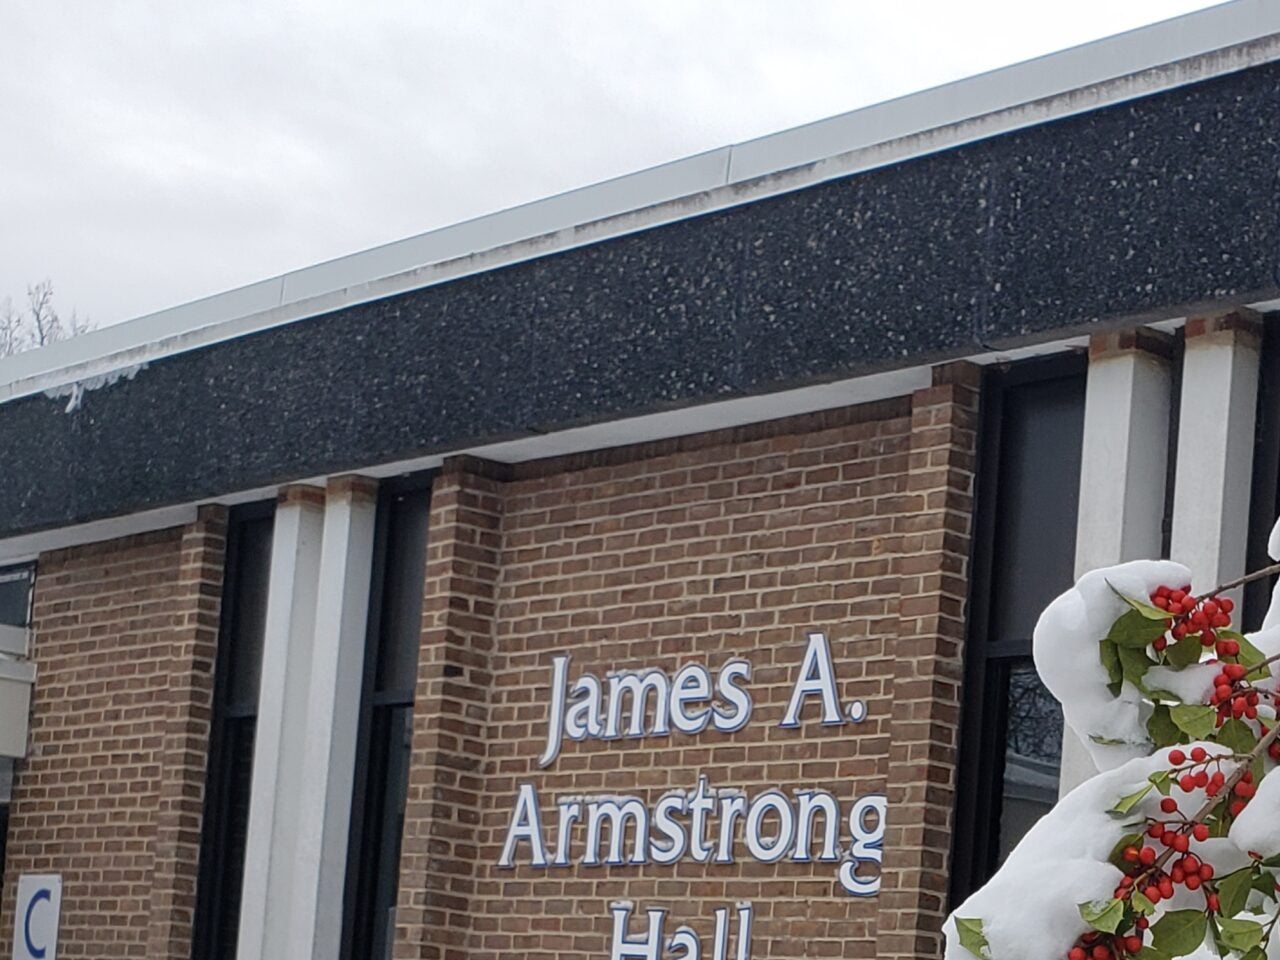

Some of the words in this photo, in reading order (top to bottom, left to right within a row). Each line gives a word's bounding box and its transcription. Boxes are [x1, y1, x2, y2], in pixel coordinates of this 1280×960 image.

[538, 653, 753, 769] James
[778, 631, 868, 729] A.
[496, 773, 888, 897] Armstrong
[24, 888, 51, 960] C
